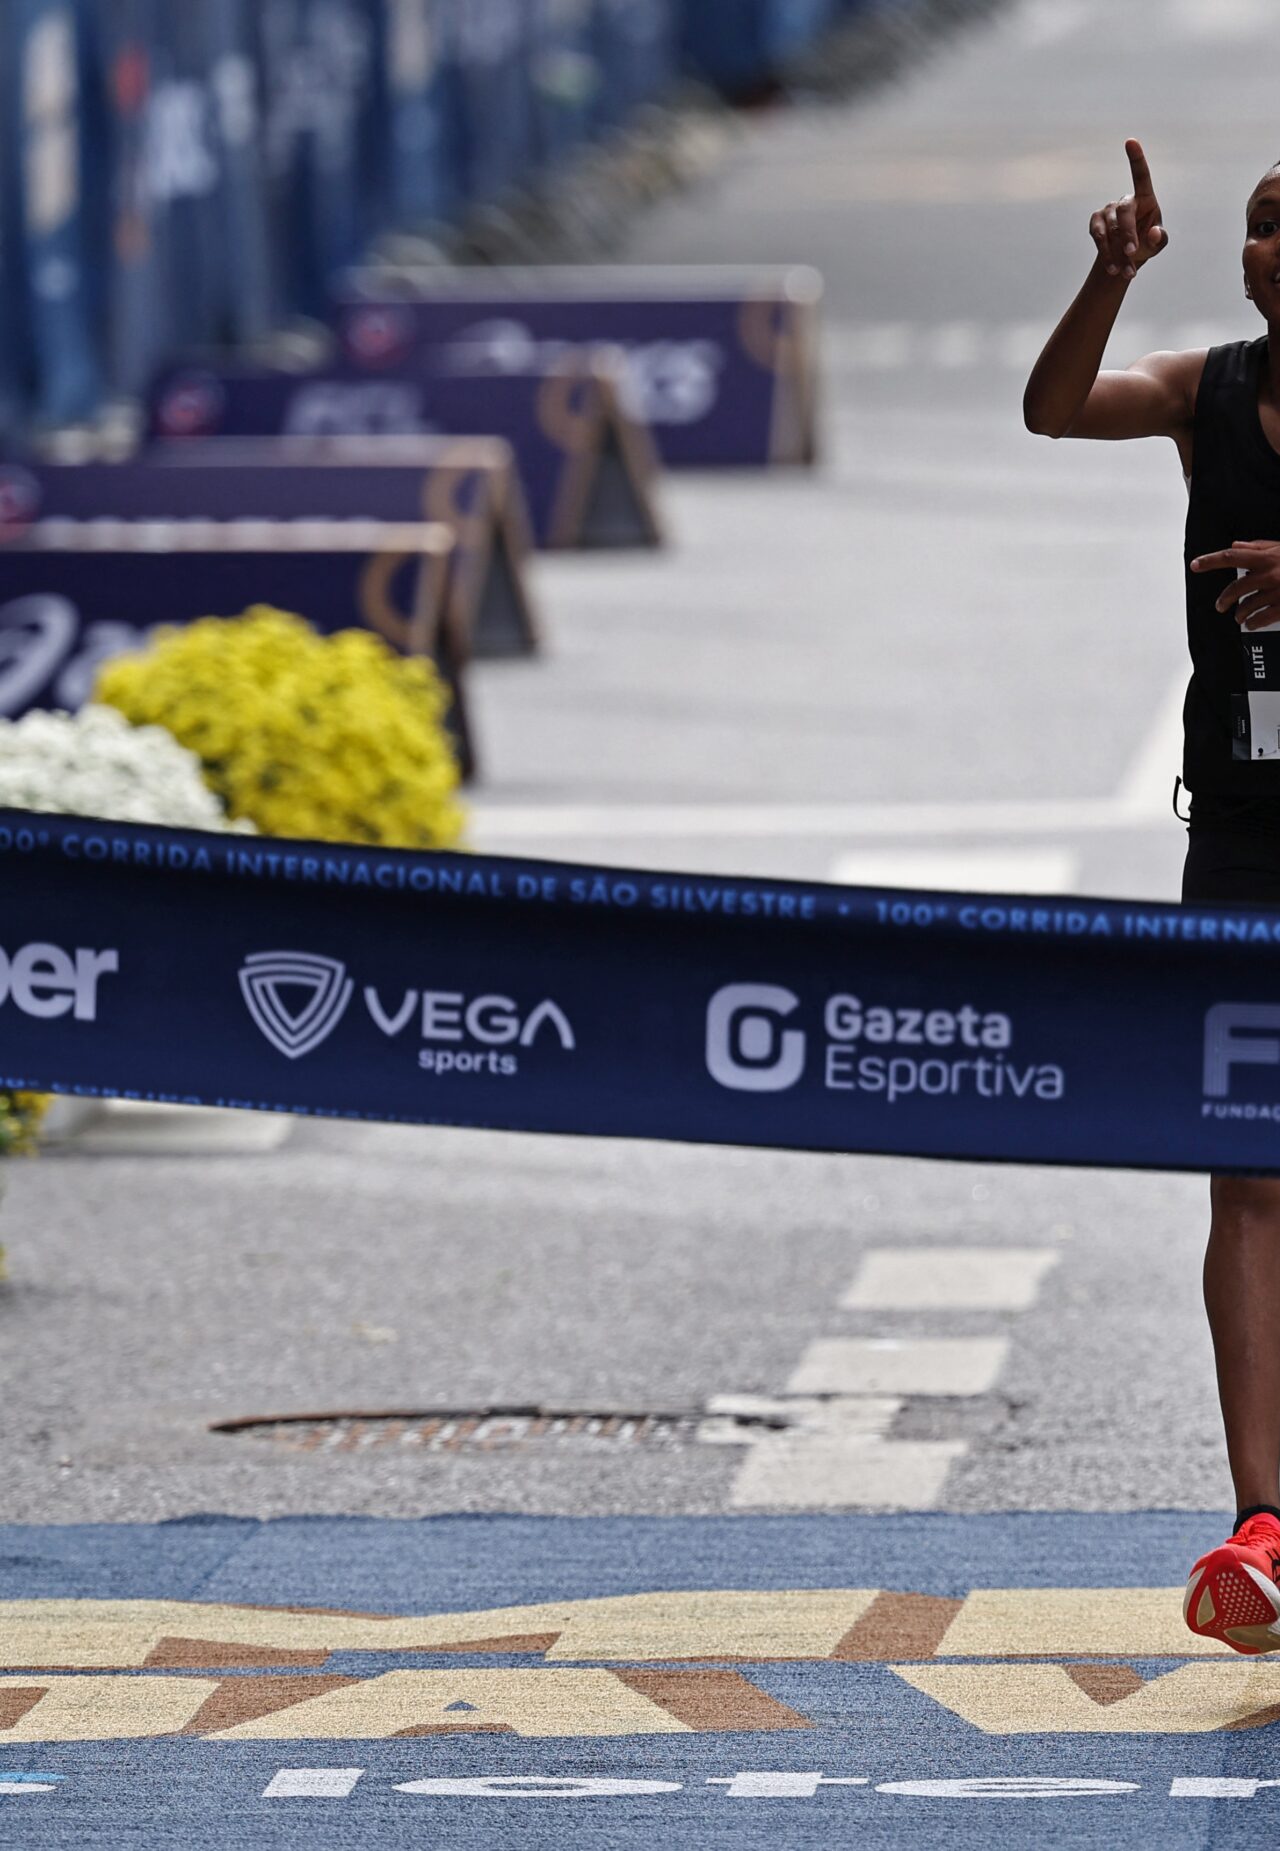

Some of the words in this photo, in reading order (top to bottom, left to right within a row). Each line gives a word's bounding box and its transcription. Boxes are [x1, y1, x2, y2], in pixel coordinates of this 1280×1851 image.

[1252, 645, 1265, 679] ELITE
[62, 833, 212, 872] CORRIDA
[226, 849, 502, 897] INTERNACIONAL
[517, 875, 557, 902] DE
[570, 875, 639, 907] SÃO
[650, 884, 816, 918] SILVESTRE
[958, 907, 1112, 935] CORRIDA
[0, 942, 118, 1021] er
[364, 985, 576, 1050] VEGA
[824, 993, 1012, 1048] Gazeta
[417, 1049, 518, 1076] sports
[825, 1043, 1064, 1102] Esportiva
